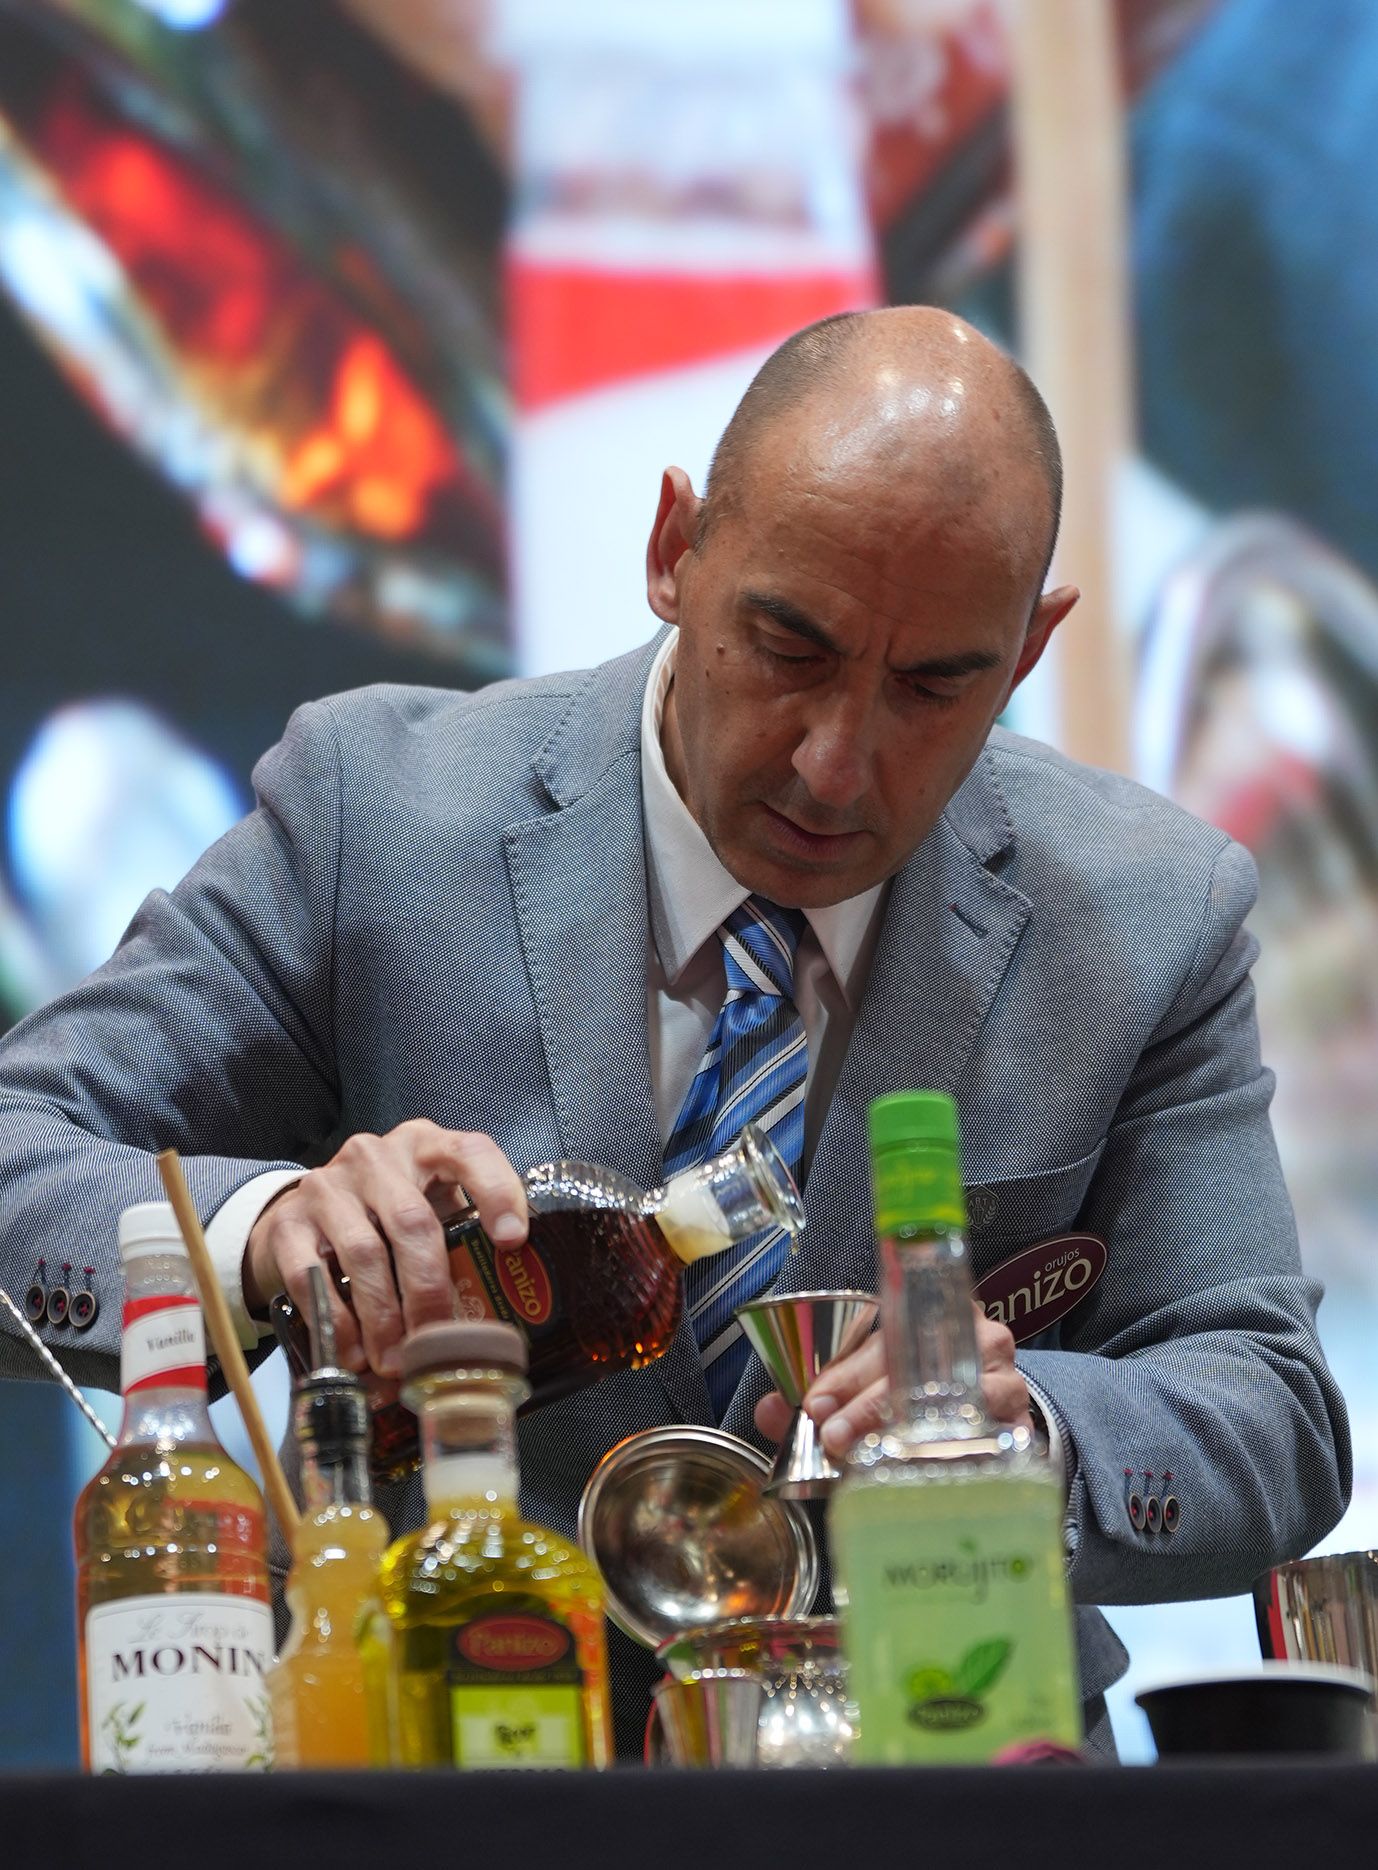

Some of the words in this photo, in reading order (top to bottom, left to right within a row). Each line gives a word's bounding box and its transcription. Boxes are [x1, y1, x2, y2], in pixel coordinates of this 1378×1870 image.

[1044, 1247, 1081, 1273] orujos
[504, 1249, 542, 1317] anizo
[111, 1645, 268, 1684] MONIN
